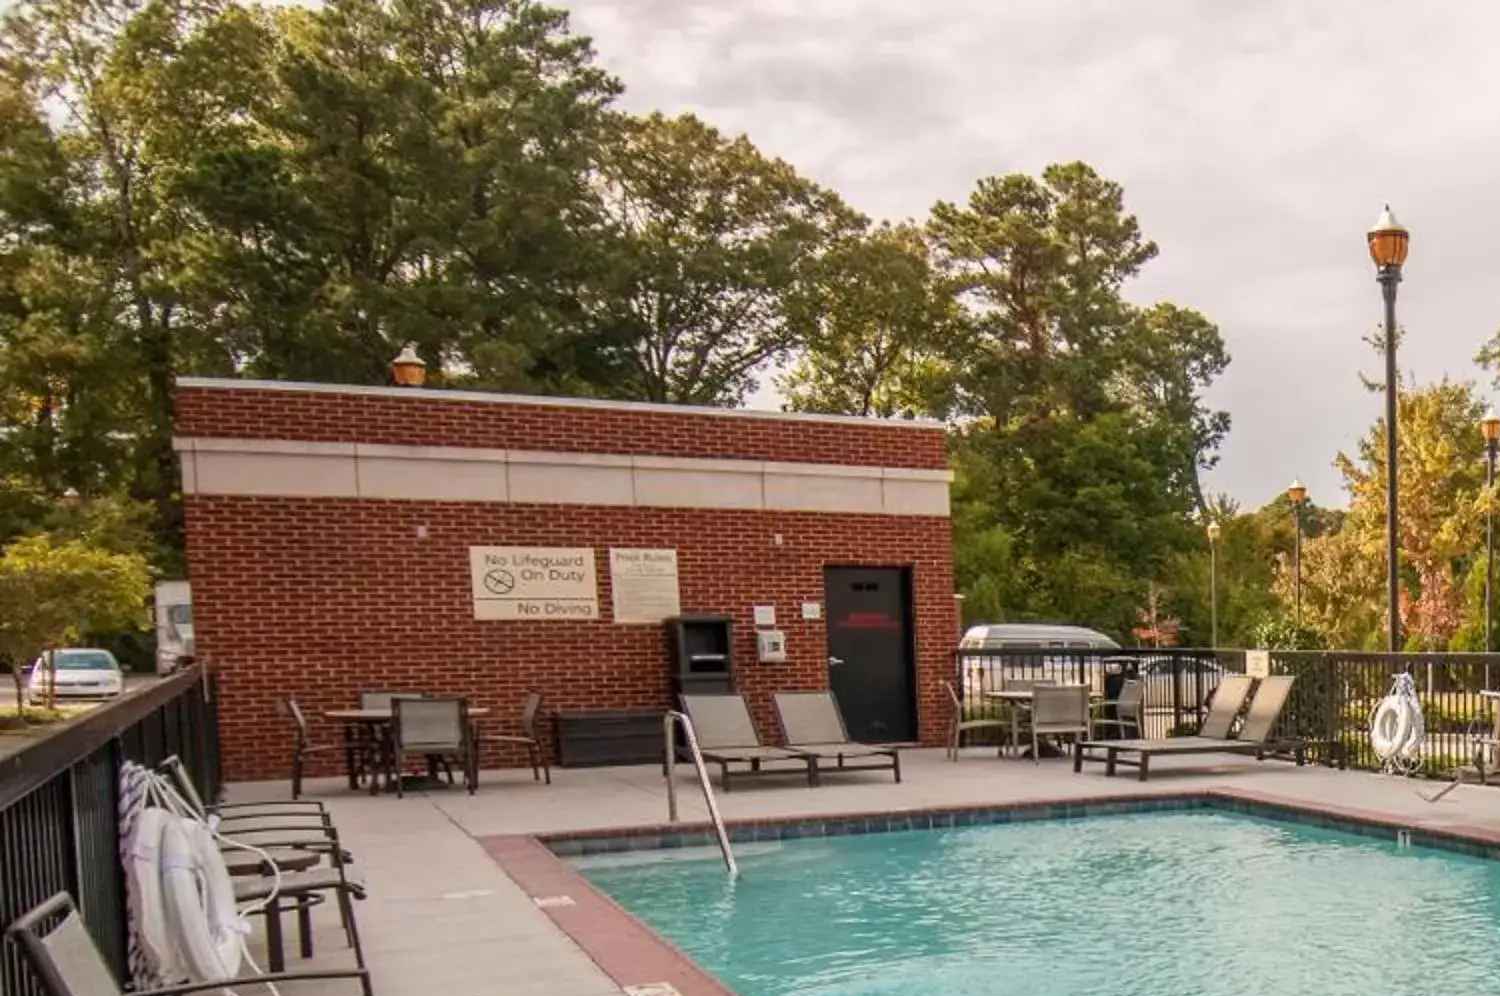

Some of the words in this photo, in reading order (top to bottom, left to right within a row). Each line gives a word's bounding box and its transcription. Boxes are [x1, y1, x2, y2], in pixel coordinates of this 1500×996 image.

[485, 554, 507, 566] No
[512, 554, 584, 569] Lifeguard
[520, 569, 544, 581] On
[548, 569, 585, 583] Duty
[517, 604, 539, 616] No
[544, 603, 591, 617] Diving
